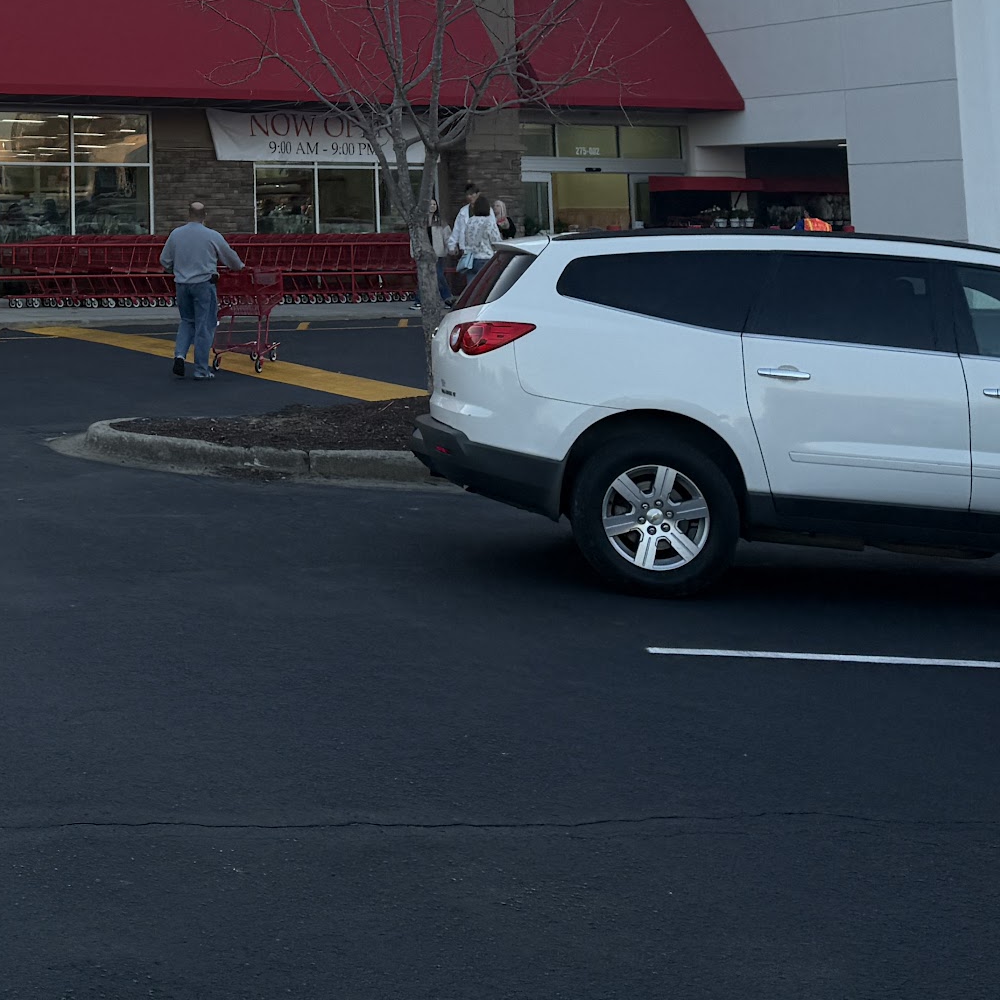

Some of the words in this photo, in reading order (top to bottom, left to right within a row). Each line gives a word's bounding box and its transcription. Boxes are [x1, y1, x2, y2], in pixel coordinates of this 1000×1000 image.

[250, 113, 316, 137] NOW
[268, 141, 292, 155] 9:00
[296, 142, 319, 155] AM
[331, 142, 355, 156] 9:00
[575, 146, 600, 156] 275-002
